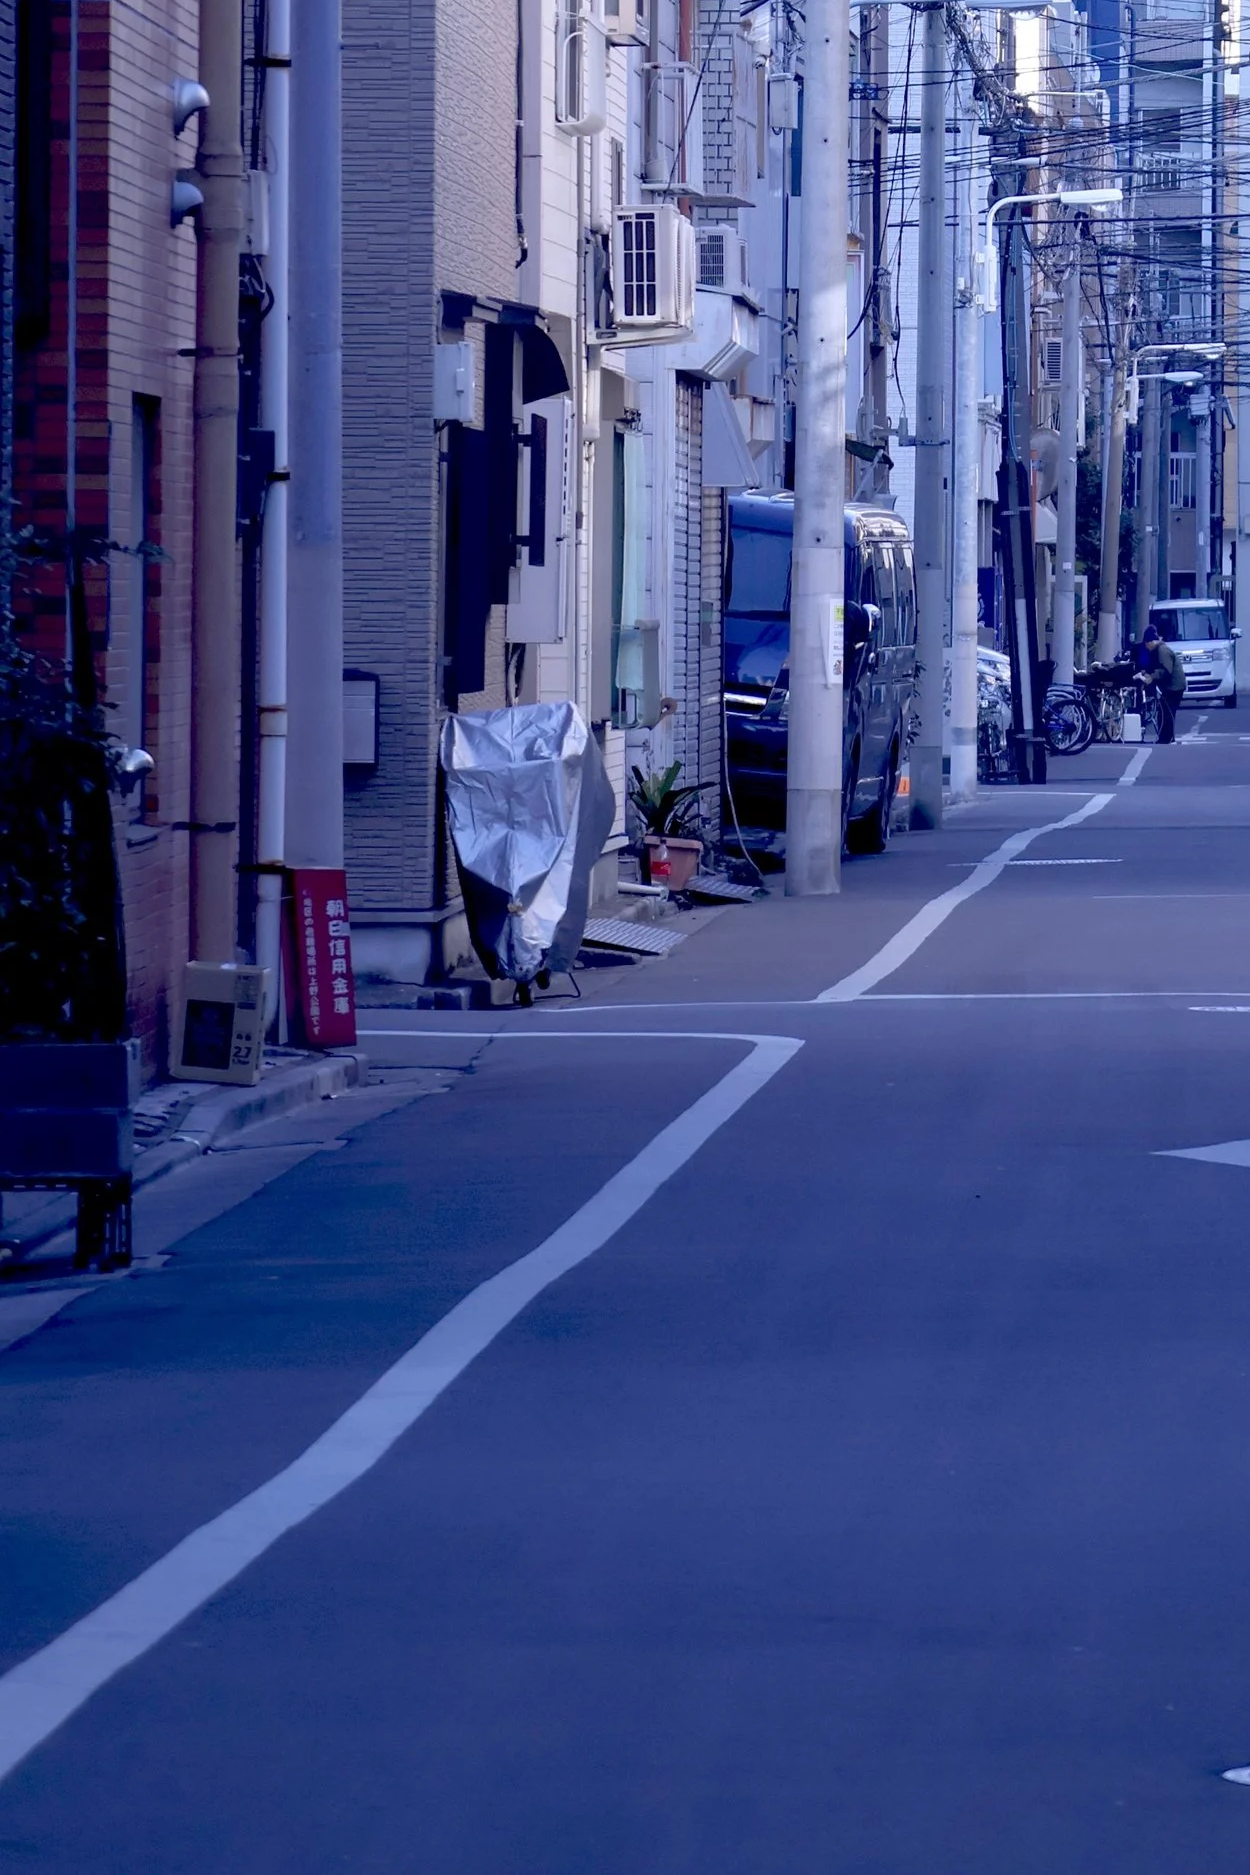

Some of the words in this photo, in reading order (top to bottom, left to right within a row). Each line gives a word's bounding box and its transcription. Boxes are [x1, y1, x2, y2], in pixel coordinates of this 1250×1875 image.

[326, 899, 350, 1015] 朝日信用金庫
